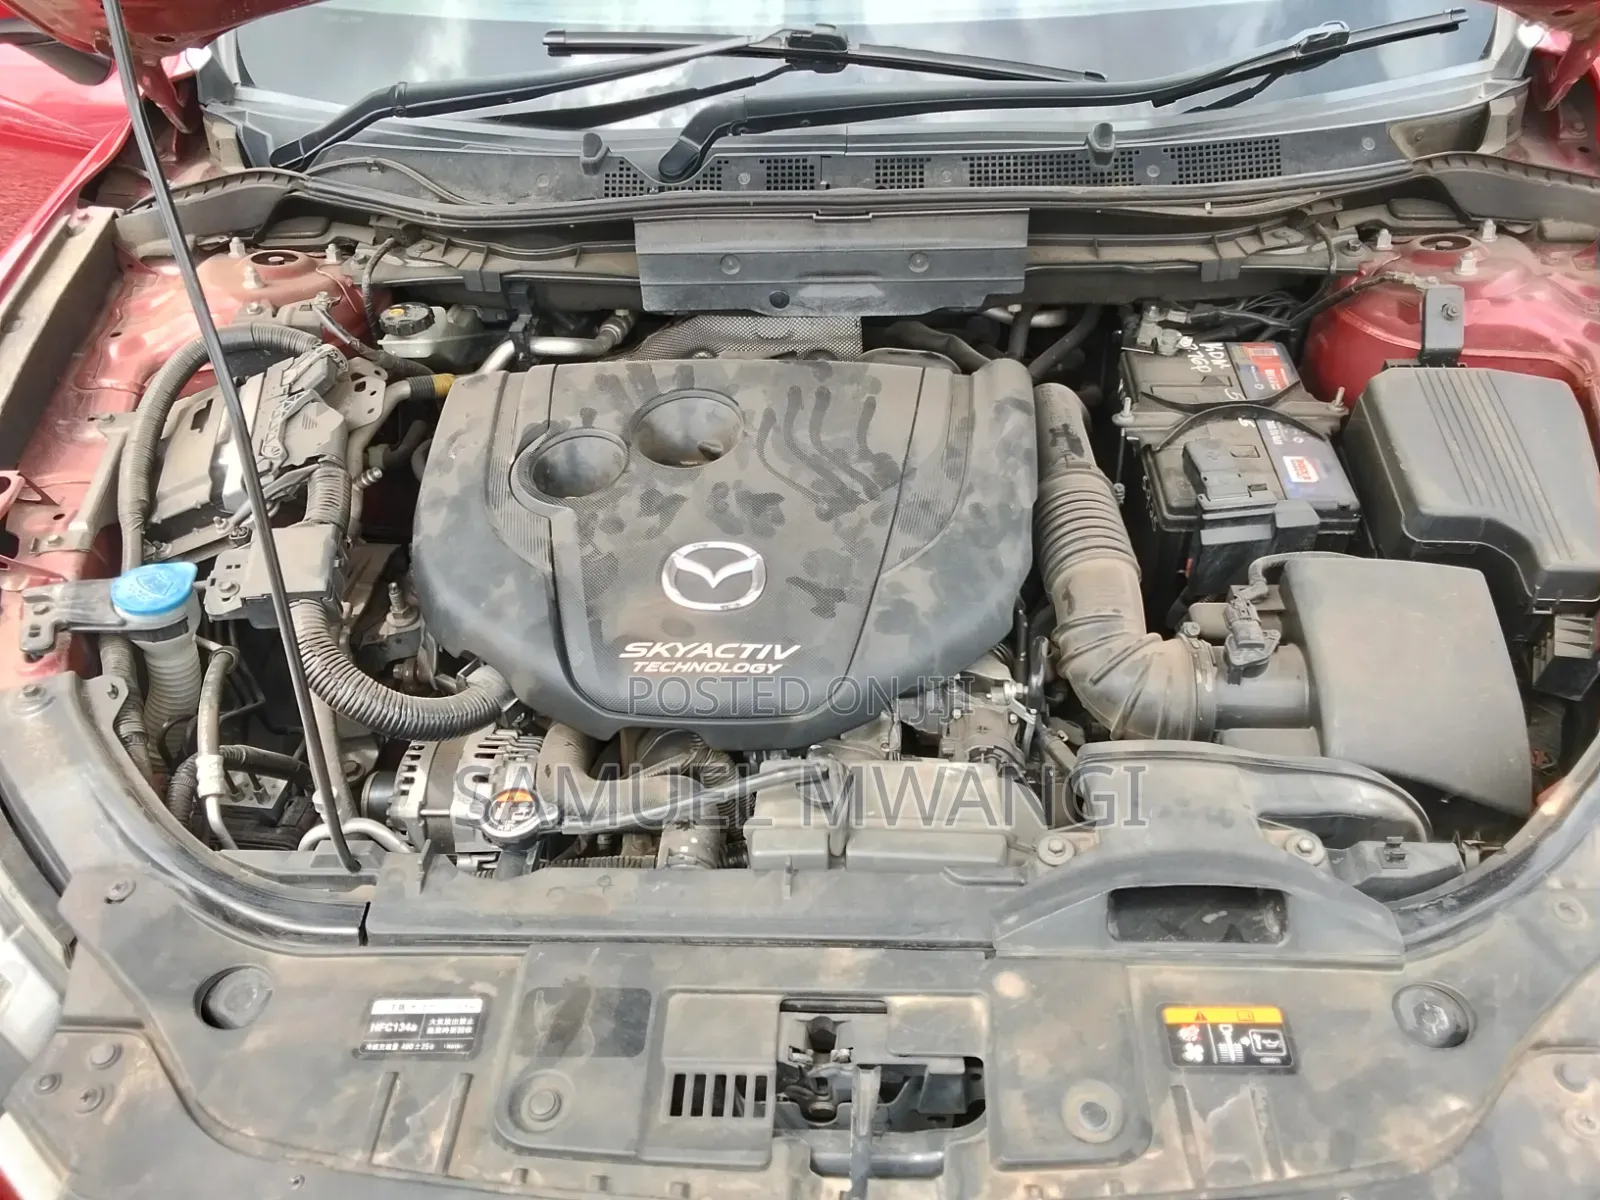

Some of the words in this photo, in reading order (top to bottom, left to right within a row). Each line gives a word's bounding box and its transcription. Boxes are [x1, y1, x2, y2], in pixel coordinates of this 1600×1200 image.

[619, 642, 801, 660] SKYACTIV
[633, 661, 783, 674] TECHNOLOGY
[369, 1022, 418, 1033] HFC134a
